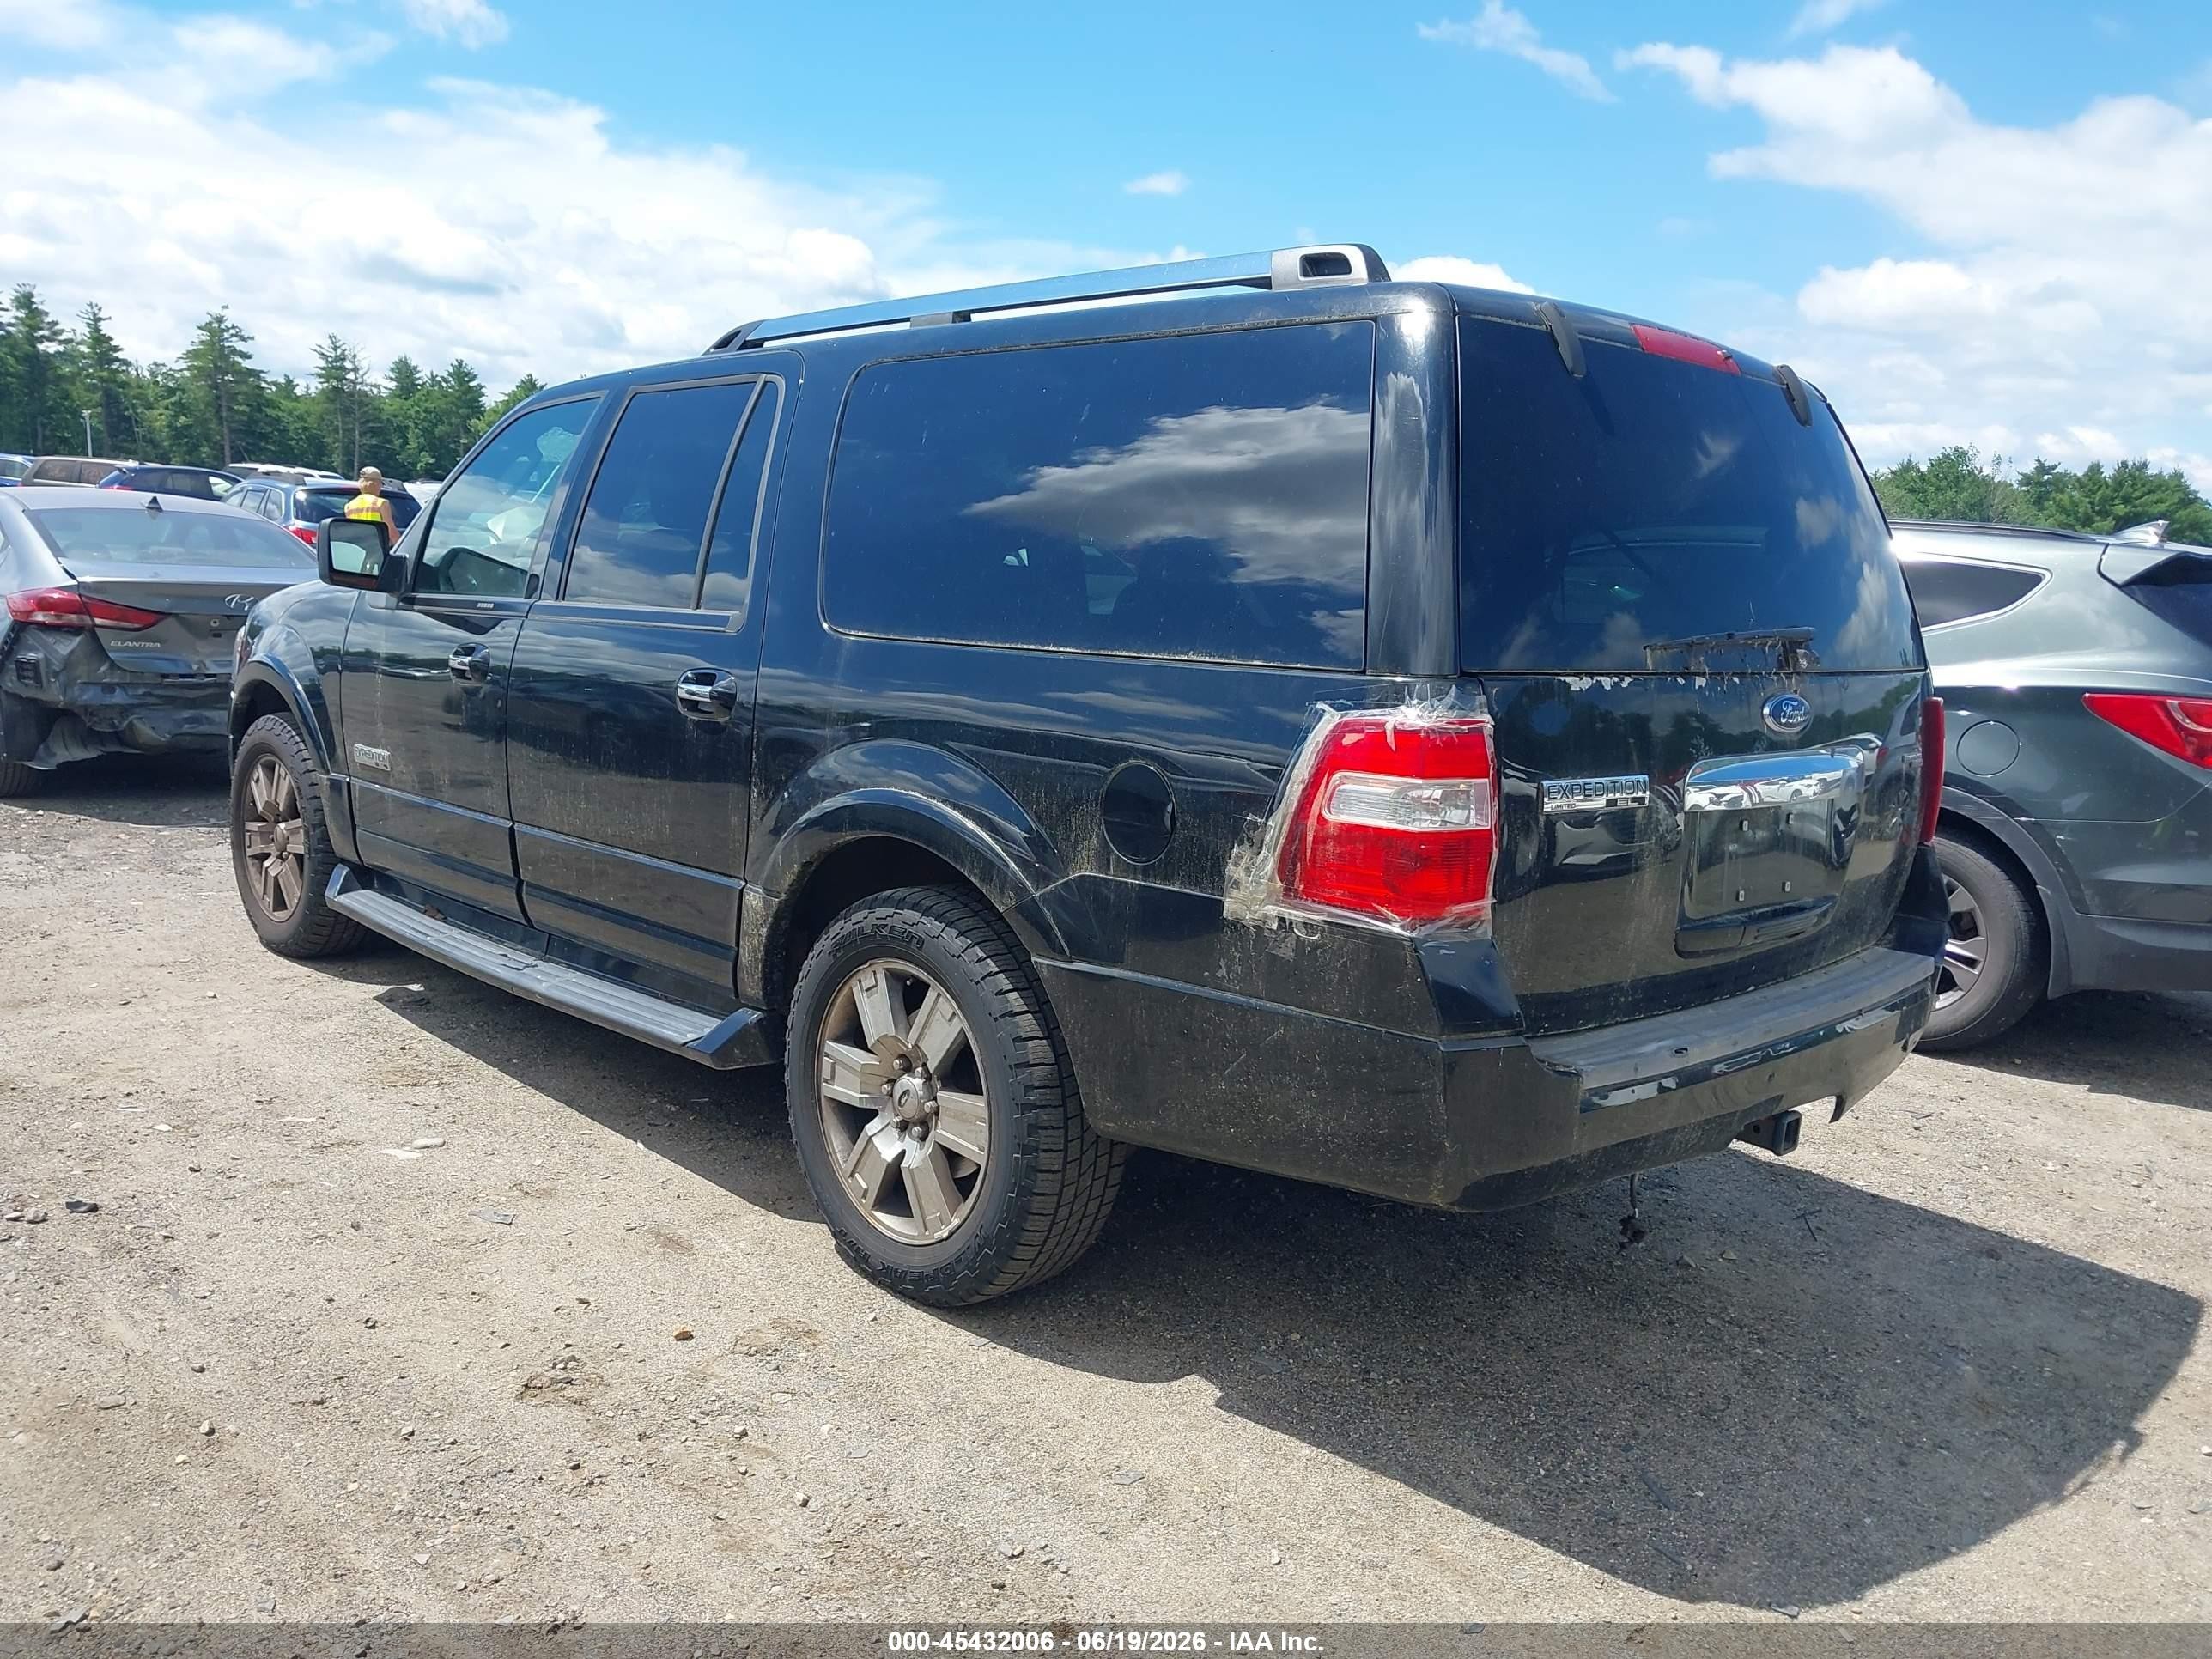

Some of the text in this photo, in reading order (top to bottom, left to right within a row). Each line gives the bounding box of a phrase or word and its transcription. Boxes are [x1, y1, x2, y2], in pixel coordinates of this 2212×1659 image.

[110, 640, 161, 648] ELANTRA
[1781, 700, 1808, 723] Ford
[1547, 779, 1647, 800] EXPEDITION
[1551, 802, 1577, 811] LIMITED
